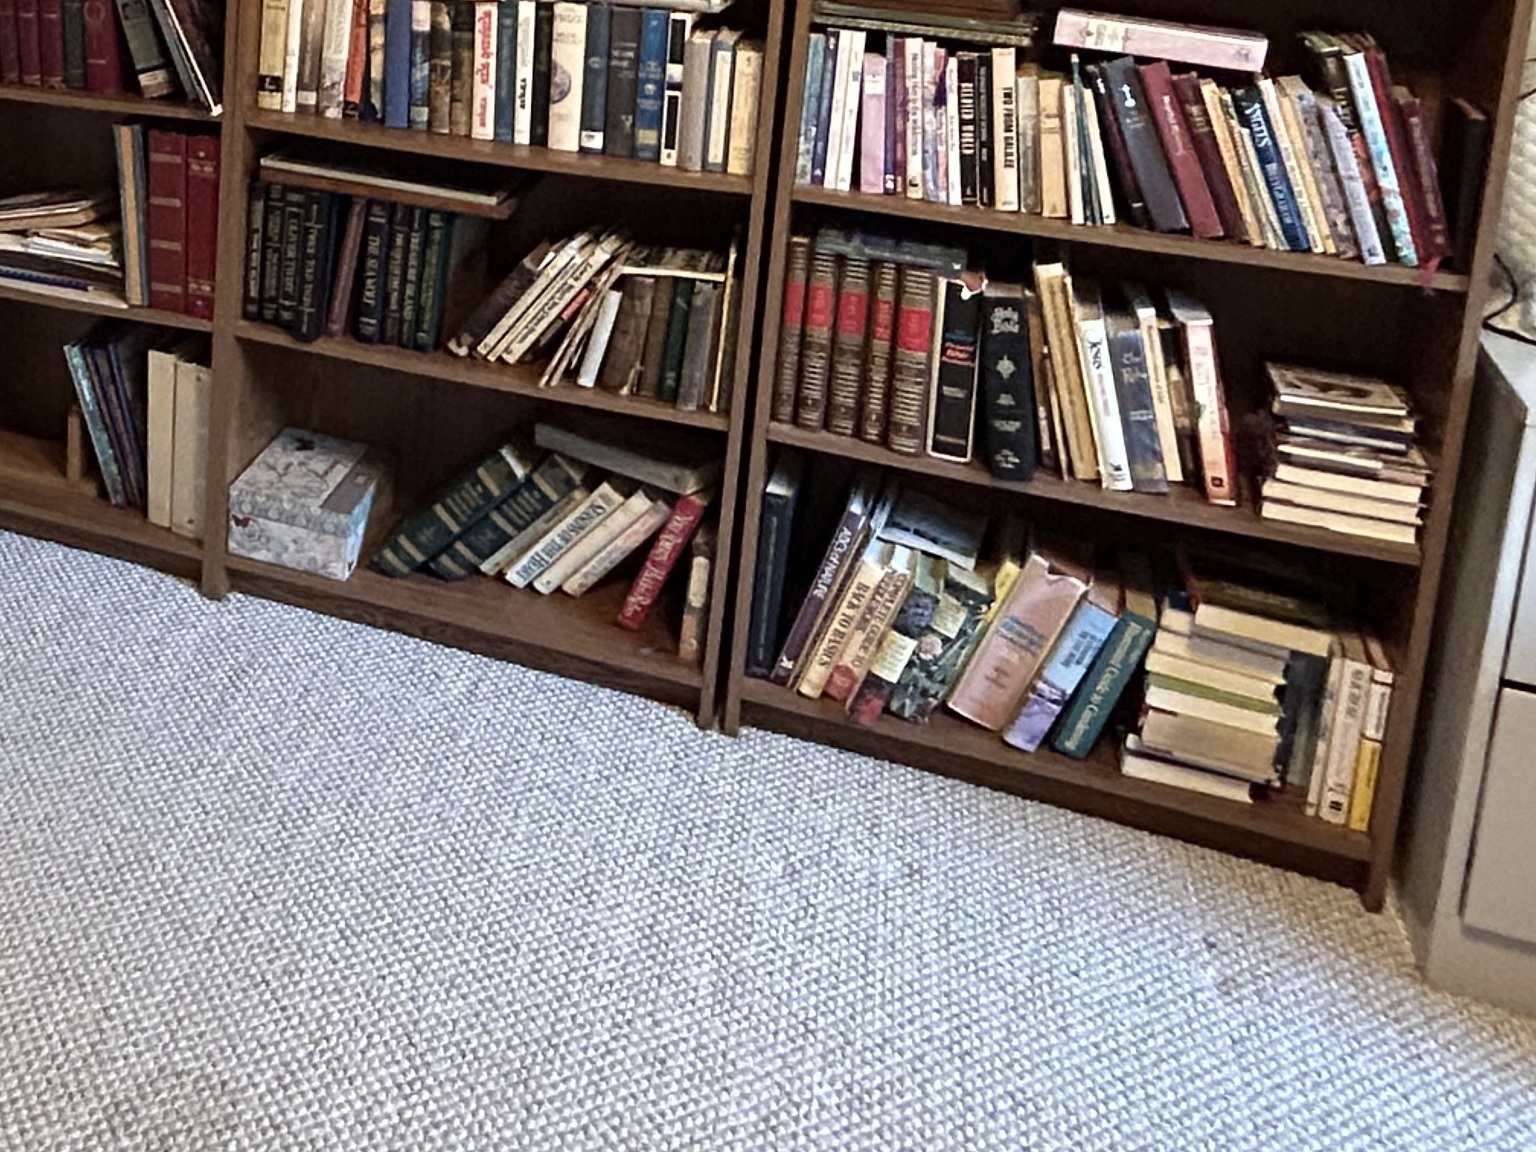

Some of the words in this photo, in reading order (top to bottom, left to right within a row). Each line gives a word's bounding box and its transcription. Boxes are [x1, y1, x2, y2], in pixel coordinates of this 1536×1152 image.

[1003, 87, 1013, 106] TWO
[1003, 108, 1014, 133] FROM
[1241, 102, 1272, 149] ANGELS
[1003, 136, 1015, 169] GALILEE
[566, 504, 606, 535] SEASONS
[515, 553, 550, 582] HEART
[846, 582, 870, 610] BACK
[838, 613, 854, 628] TO
[818, 629, 847, 669] BASICS
